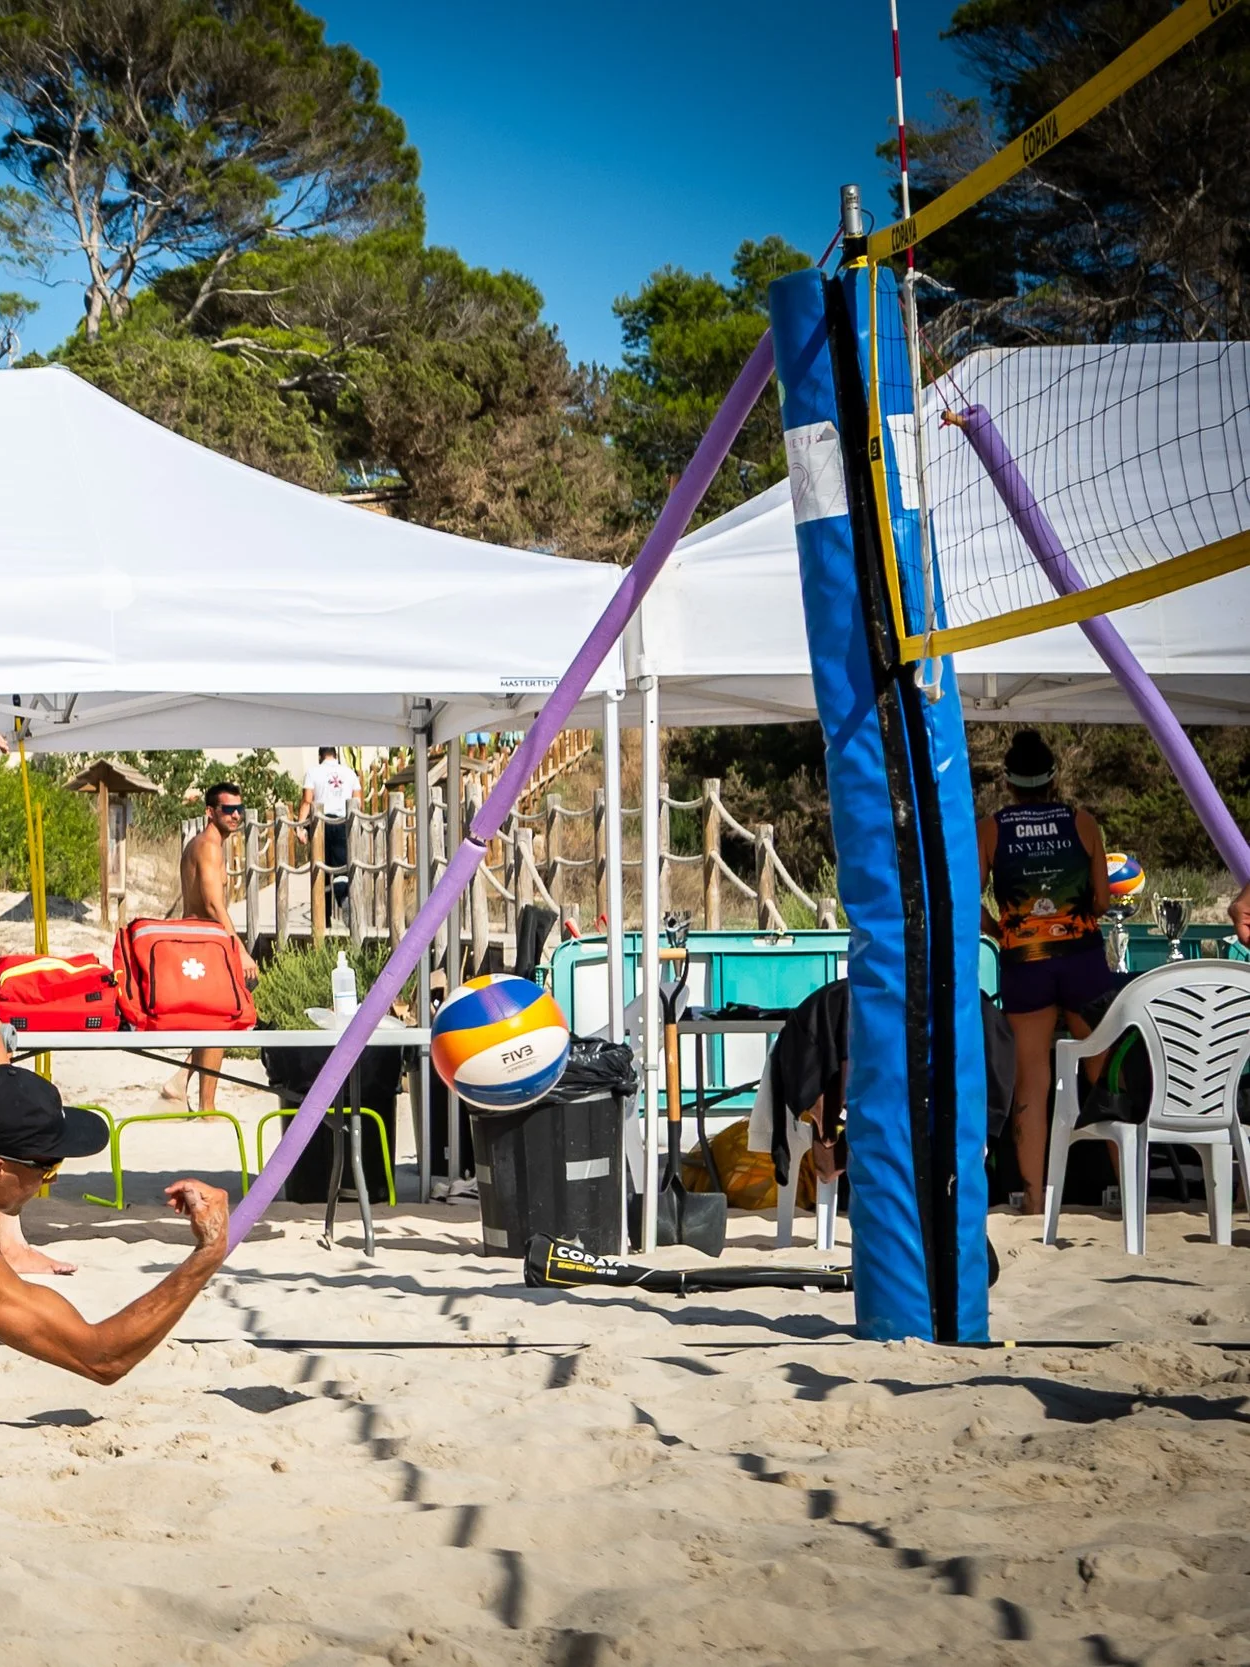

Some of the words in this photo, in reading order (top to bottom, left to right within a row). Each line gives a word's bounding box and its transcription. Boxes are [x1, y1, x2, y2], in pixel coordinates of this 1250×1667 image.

[1023, 114, 1060, 163] COPAYA
[892, 216, 918, 252] COPAYA
[871, 441, 878, 457] 2
[1015, 822, 1059, 838] CARLA
[1008, 839, 1072, 854] INVENIO
[501, 1045, 534, 1064] FIVB
